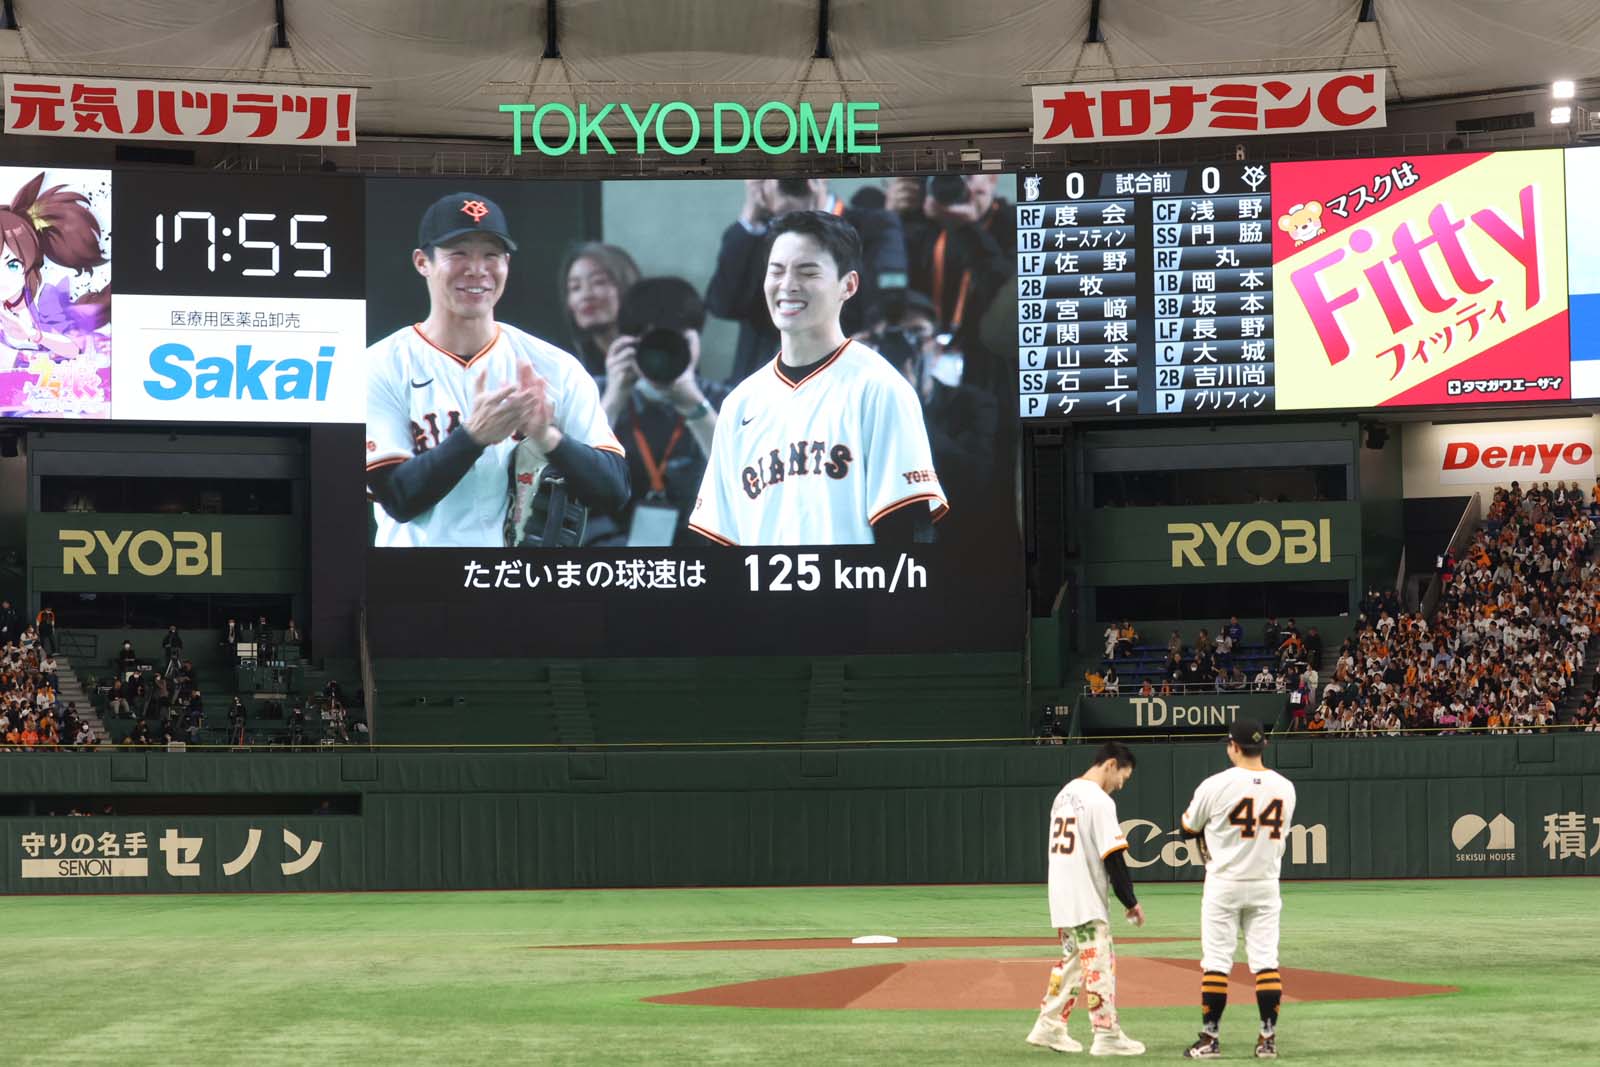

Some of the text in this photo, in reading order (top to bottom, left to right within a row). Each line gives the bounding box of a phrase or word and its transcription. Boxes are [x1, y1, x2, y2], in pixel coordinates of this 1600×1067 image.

[11, 83, 352, 143] 元気ハツラツ!
[1043, 74, 1377, 140] オロナミンC
[498, 101, 881, 156] TOKYO DOME
[1065, 172, 1085, 200] 0
[1115, 171, 1171, 195] 試合前
[1201, 166, 1221, 194] 0
[1325, 161, 1420, 218] マスクは
[1021, 208, 1040, 226] RF
[1156, 203, 1176, 221] CF
[155, 211, 331, 278] 17:55
[1022, 229, 1127, 250] 1B オースティン
[1156, 227, 1177, 245] SS
[1022, 256, 1040, 273] LF
[1158, 247, 1240, 268] RF 丸
[1021, 275, 1104, 297] 2B 牧
[1159, 275, 1178, 292] 1B
[1289, 184, 1541, 367] Fitty
[1022, 303, 1042, 321] 3B
[1158, 298, 1178, 315] 3B
[171, 310, 301, 328] 医療用医薬品卸売
[1160, 322, 1178, 339] LF
[1022, 327, 1042, 344] CF
[1375, 299, 1508, 381] フィッティ
[1027, 350, 1038, 367] C
[1164, 345, 1175, 363] C
[143, 342, 336, 401] Sakai
[1022, 374, 1043, 391] SS
[1160, 364, 1266, 387] 2B 吉川尚
[1463, 377, 1562, 393] タマガワエーザイ
[1028, 398, 1038, 414] P
[1165, 390, 1266, 411] P グリフィン
[1442, 442, 1593, 474] Denyo
[742, 440, 854, 500] GIANTS
[59, 529, 223, 577] RYOBI
[1167, 518, 1331, 568] RYOBI
[463, 553, 927, 593] ただいまの球速は 125 km/h
[1129, 697, 1240, 727] TD POINT
[1228, 797, 1284, 840] 44
[21, 831, 149, 857] 守りの名手
[1051, 816, 1076, 855] 25
[1118, 818, 1327, 868] Can
[159, 828, 323, 877] セノン
[1455, 853, 1516, 862] SEKISUI HOUSE
[58, 859, 112, 877] SENON
